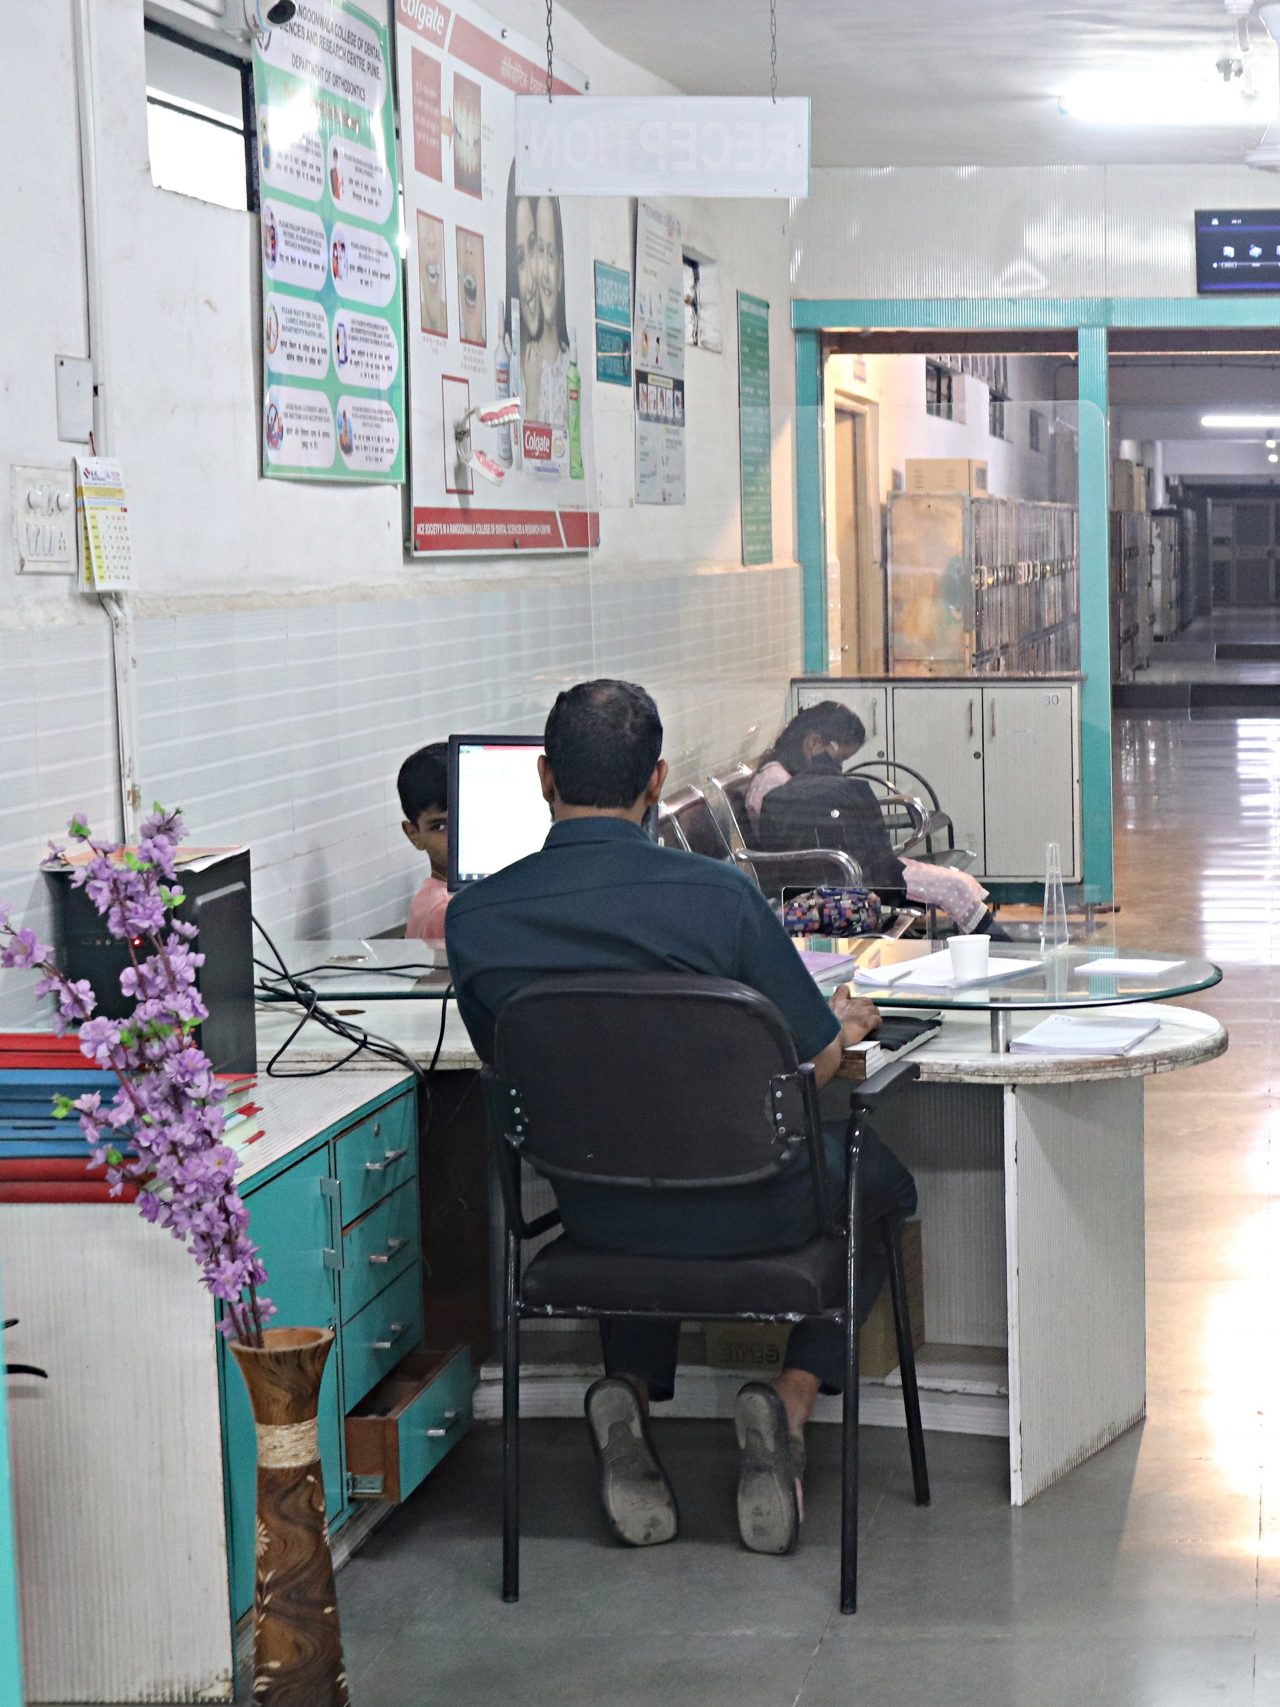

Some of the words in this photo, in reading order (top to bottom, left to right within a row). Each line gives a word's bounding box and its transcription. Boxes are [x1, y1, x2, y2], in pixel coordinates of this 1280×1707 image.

[296, 2, 334, 35] NGOONWALA
[334, 23, 356, 48] COLLEGE
[356, 37, 363, 51] OF
[363, 40, 381, 62] DENTAL
[401, 0, 444, 35] Colgate
[305, 29, 317, 46] AND
[318, 35, 345, 60] RESEARCH
[292, 54, 324, 78] DEPARTMENT
[324, 70, 331, 84] OF
[332, 73, 365, 101] ORTHODONTICS
[525, 430, 550, 456] Colgate
[1044, 694, 1059, 705] 30
